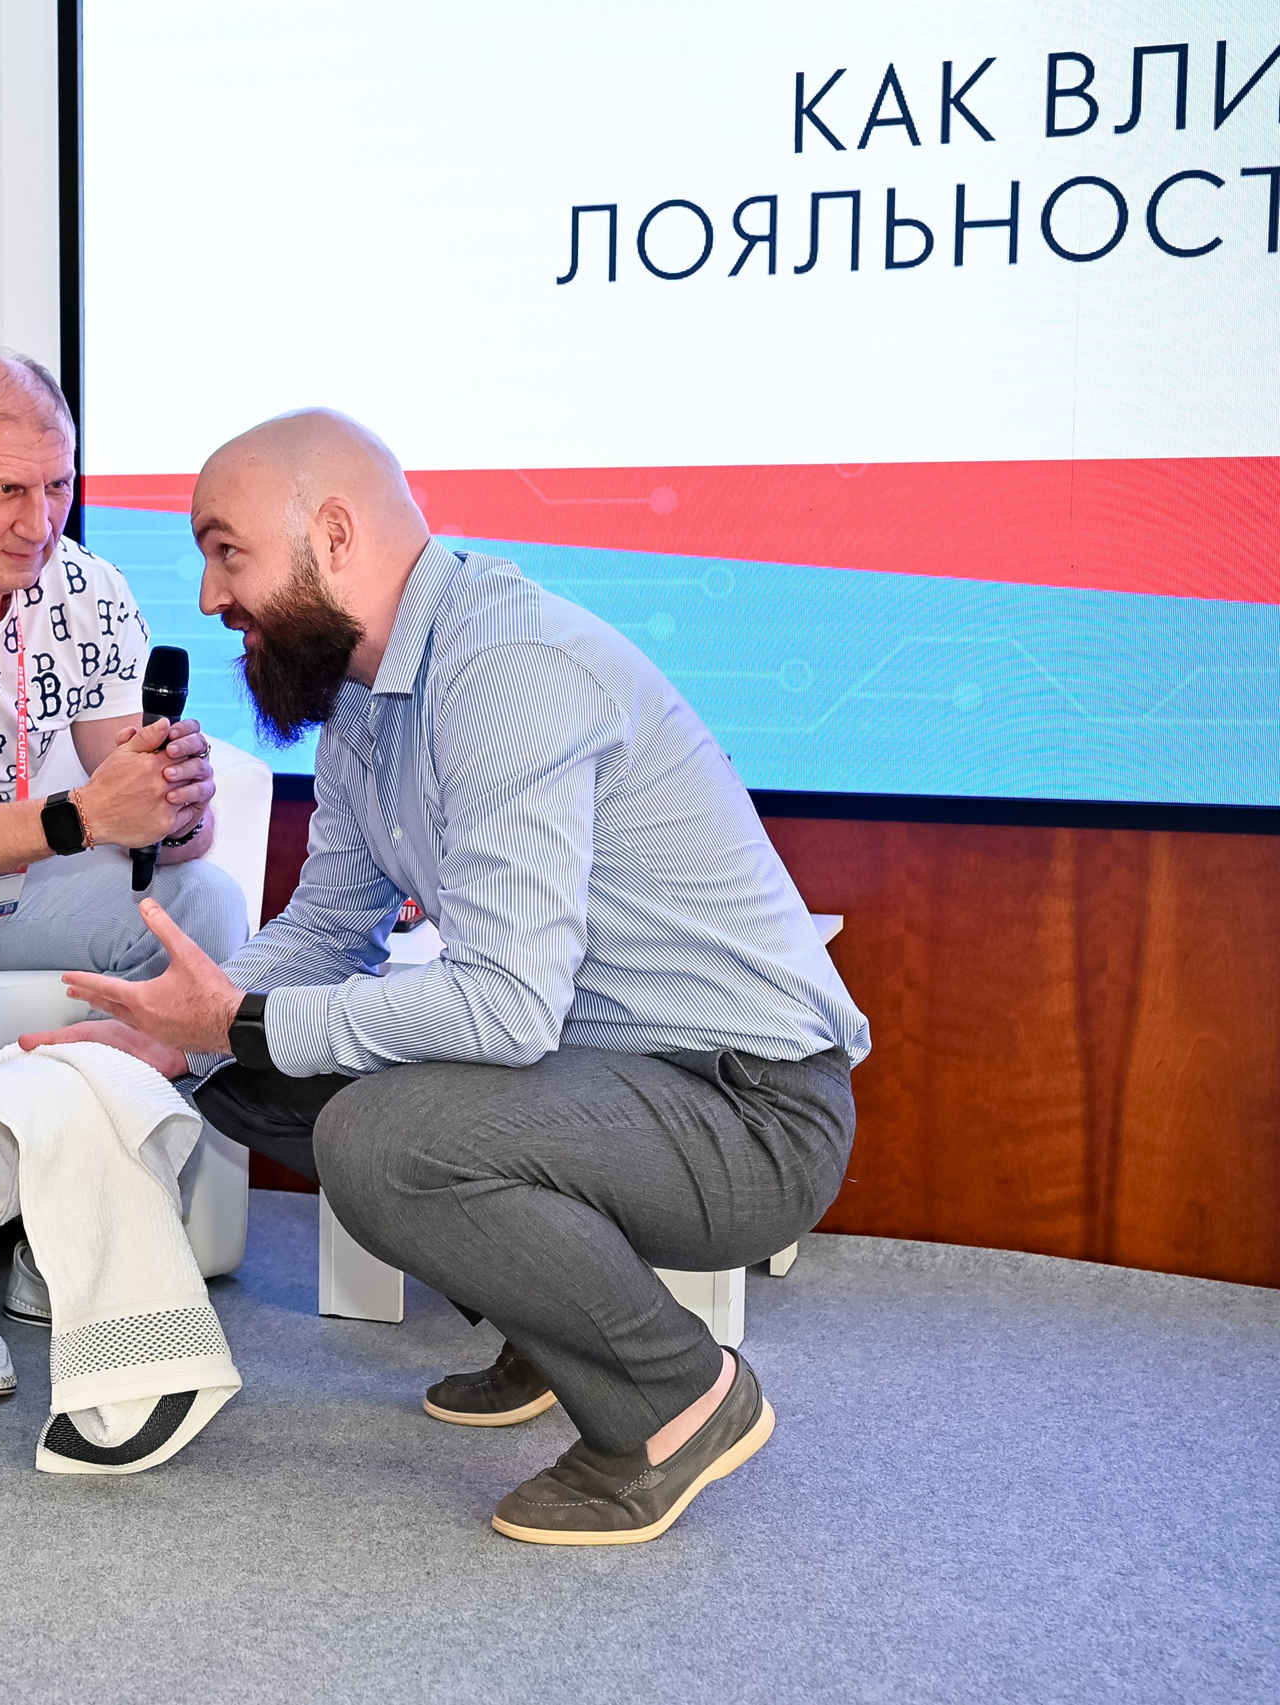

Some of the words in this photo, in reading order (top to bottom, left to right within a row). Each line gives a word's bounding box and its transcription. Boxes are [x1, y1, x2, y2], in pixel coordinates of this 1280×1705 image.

[793, 57, 998, 154] КАК
[1044, 40, 1280, 139] ВЛИ
[556, 165, 1280, 285] ЛОЯЛЬНОСТ
[18, 715, 26, 780] SECURITY
